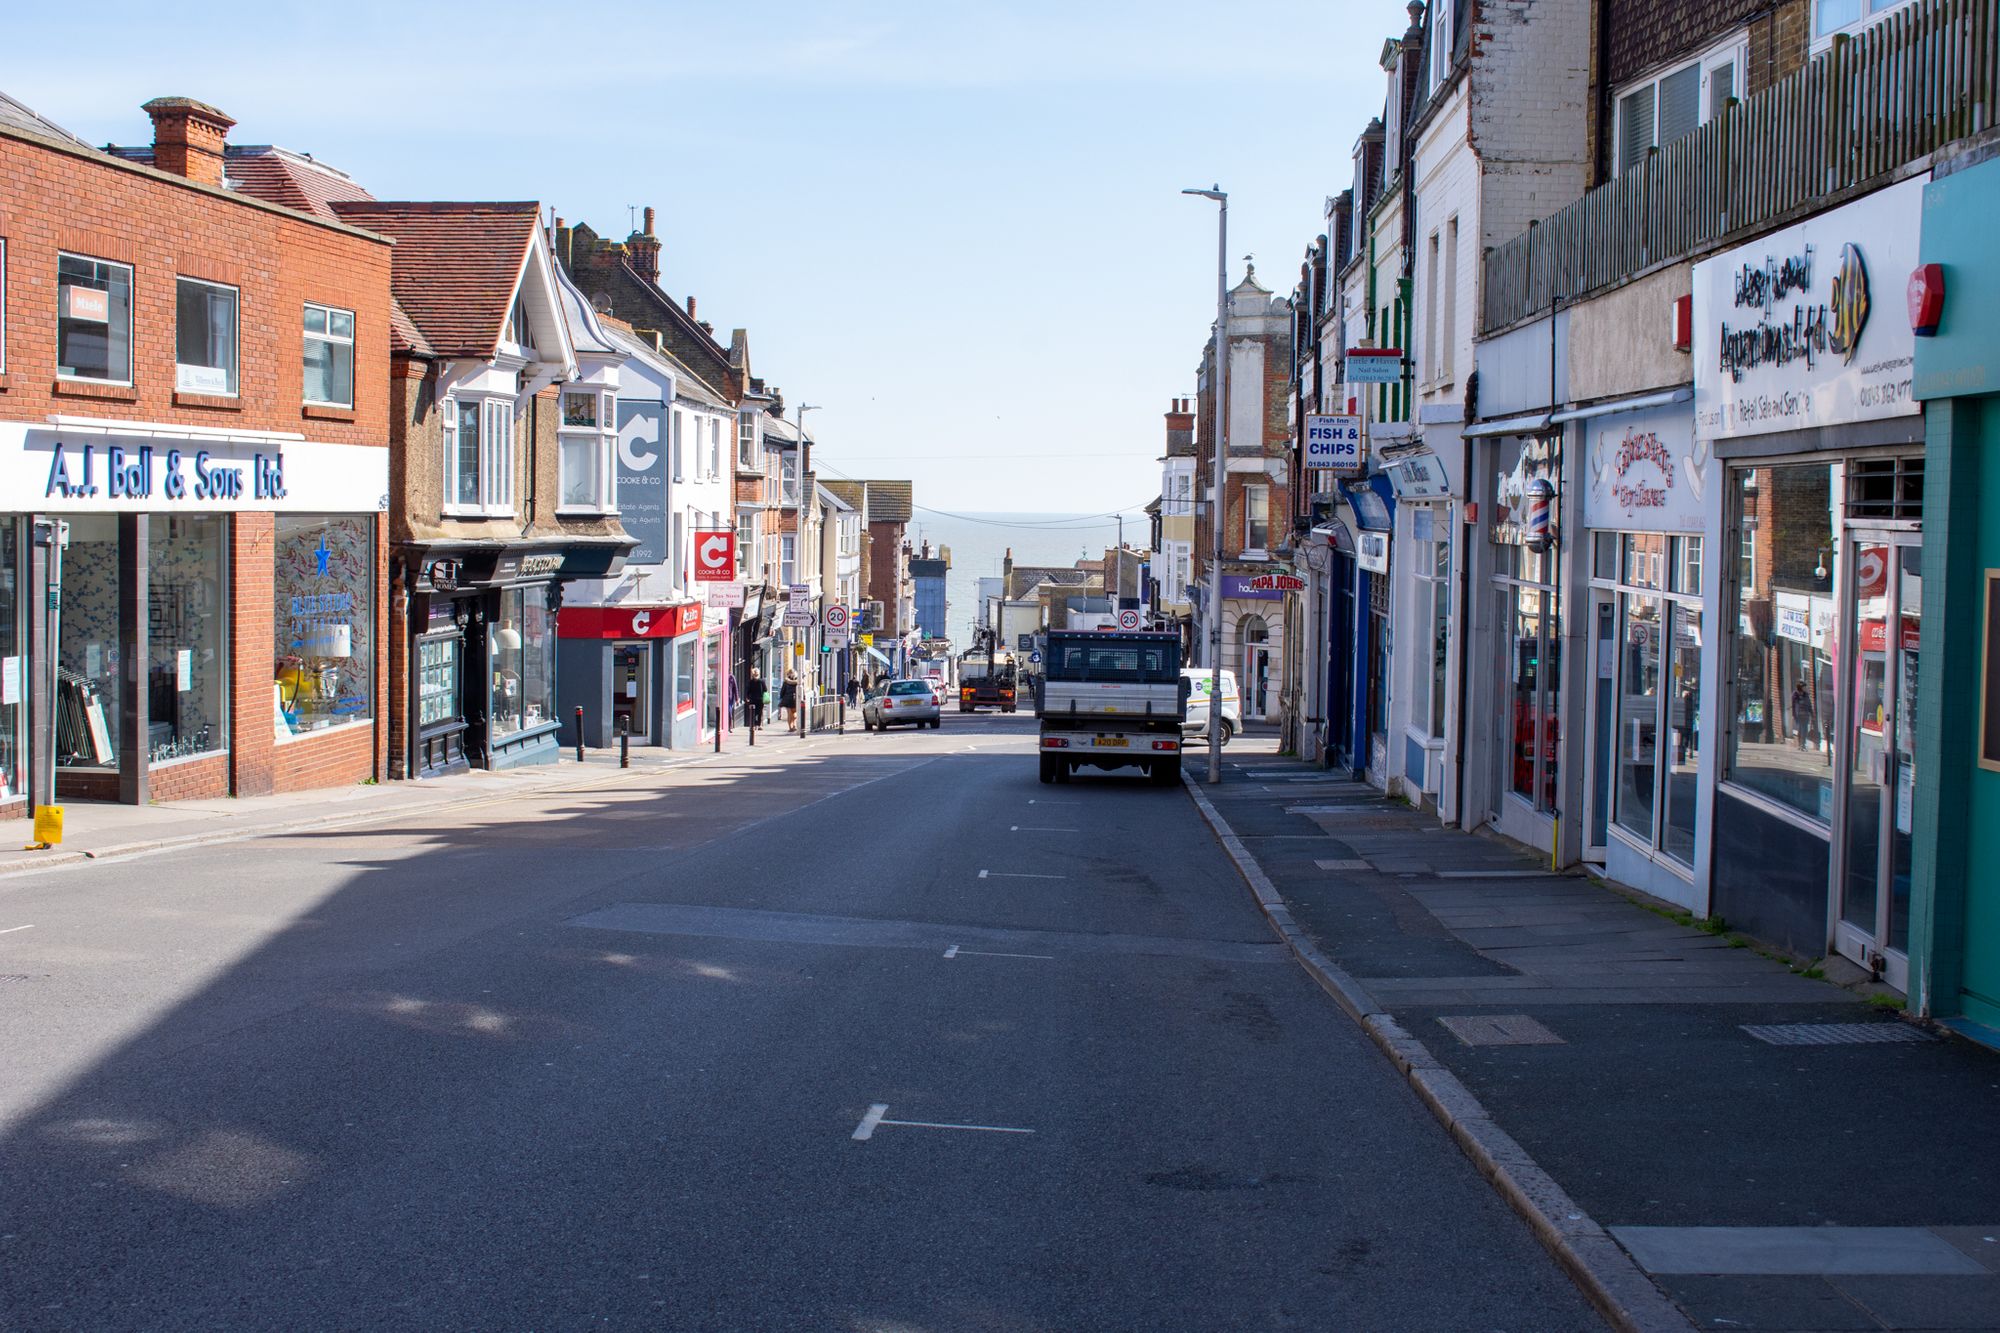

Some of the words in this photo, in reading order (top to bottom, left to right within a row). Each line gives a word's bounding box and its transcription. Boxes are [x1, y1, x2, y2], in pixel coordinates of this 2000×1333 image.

[1309, 428, 1343, 440] FISH
[1348, 428, 1359, 440] &
[1309, 443, 1355, 455] CHIPS
[45, 442, 99, 499] A.J.
[109, 446, 153, 499] Ball
[165, 449, 188, 500] &
[195, 450, 244, 500] Sons
[255, 453, 288, 500] Ltd.
[617, 476, 640, 485] COOKE
[641, 475, 648, 485] &
[649, 477, 661, 485] CO
[638, 503, 660, 512] Agents
[639, 516, 661, 525] Agents
[636, 550, 653, 558] 1992
[434, 561, 457, 579] SH
[1251, 575, 1274, 589] PAPA
[1274, 575, 1304, 590] JOHNS
[830, 612, 844, 622] 20
[1123, 616, 1136, 624] 20
